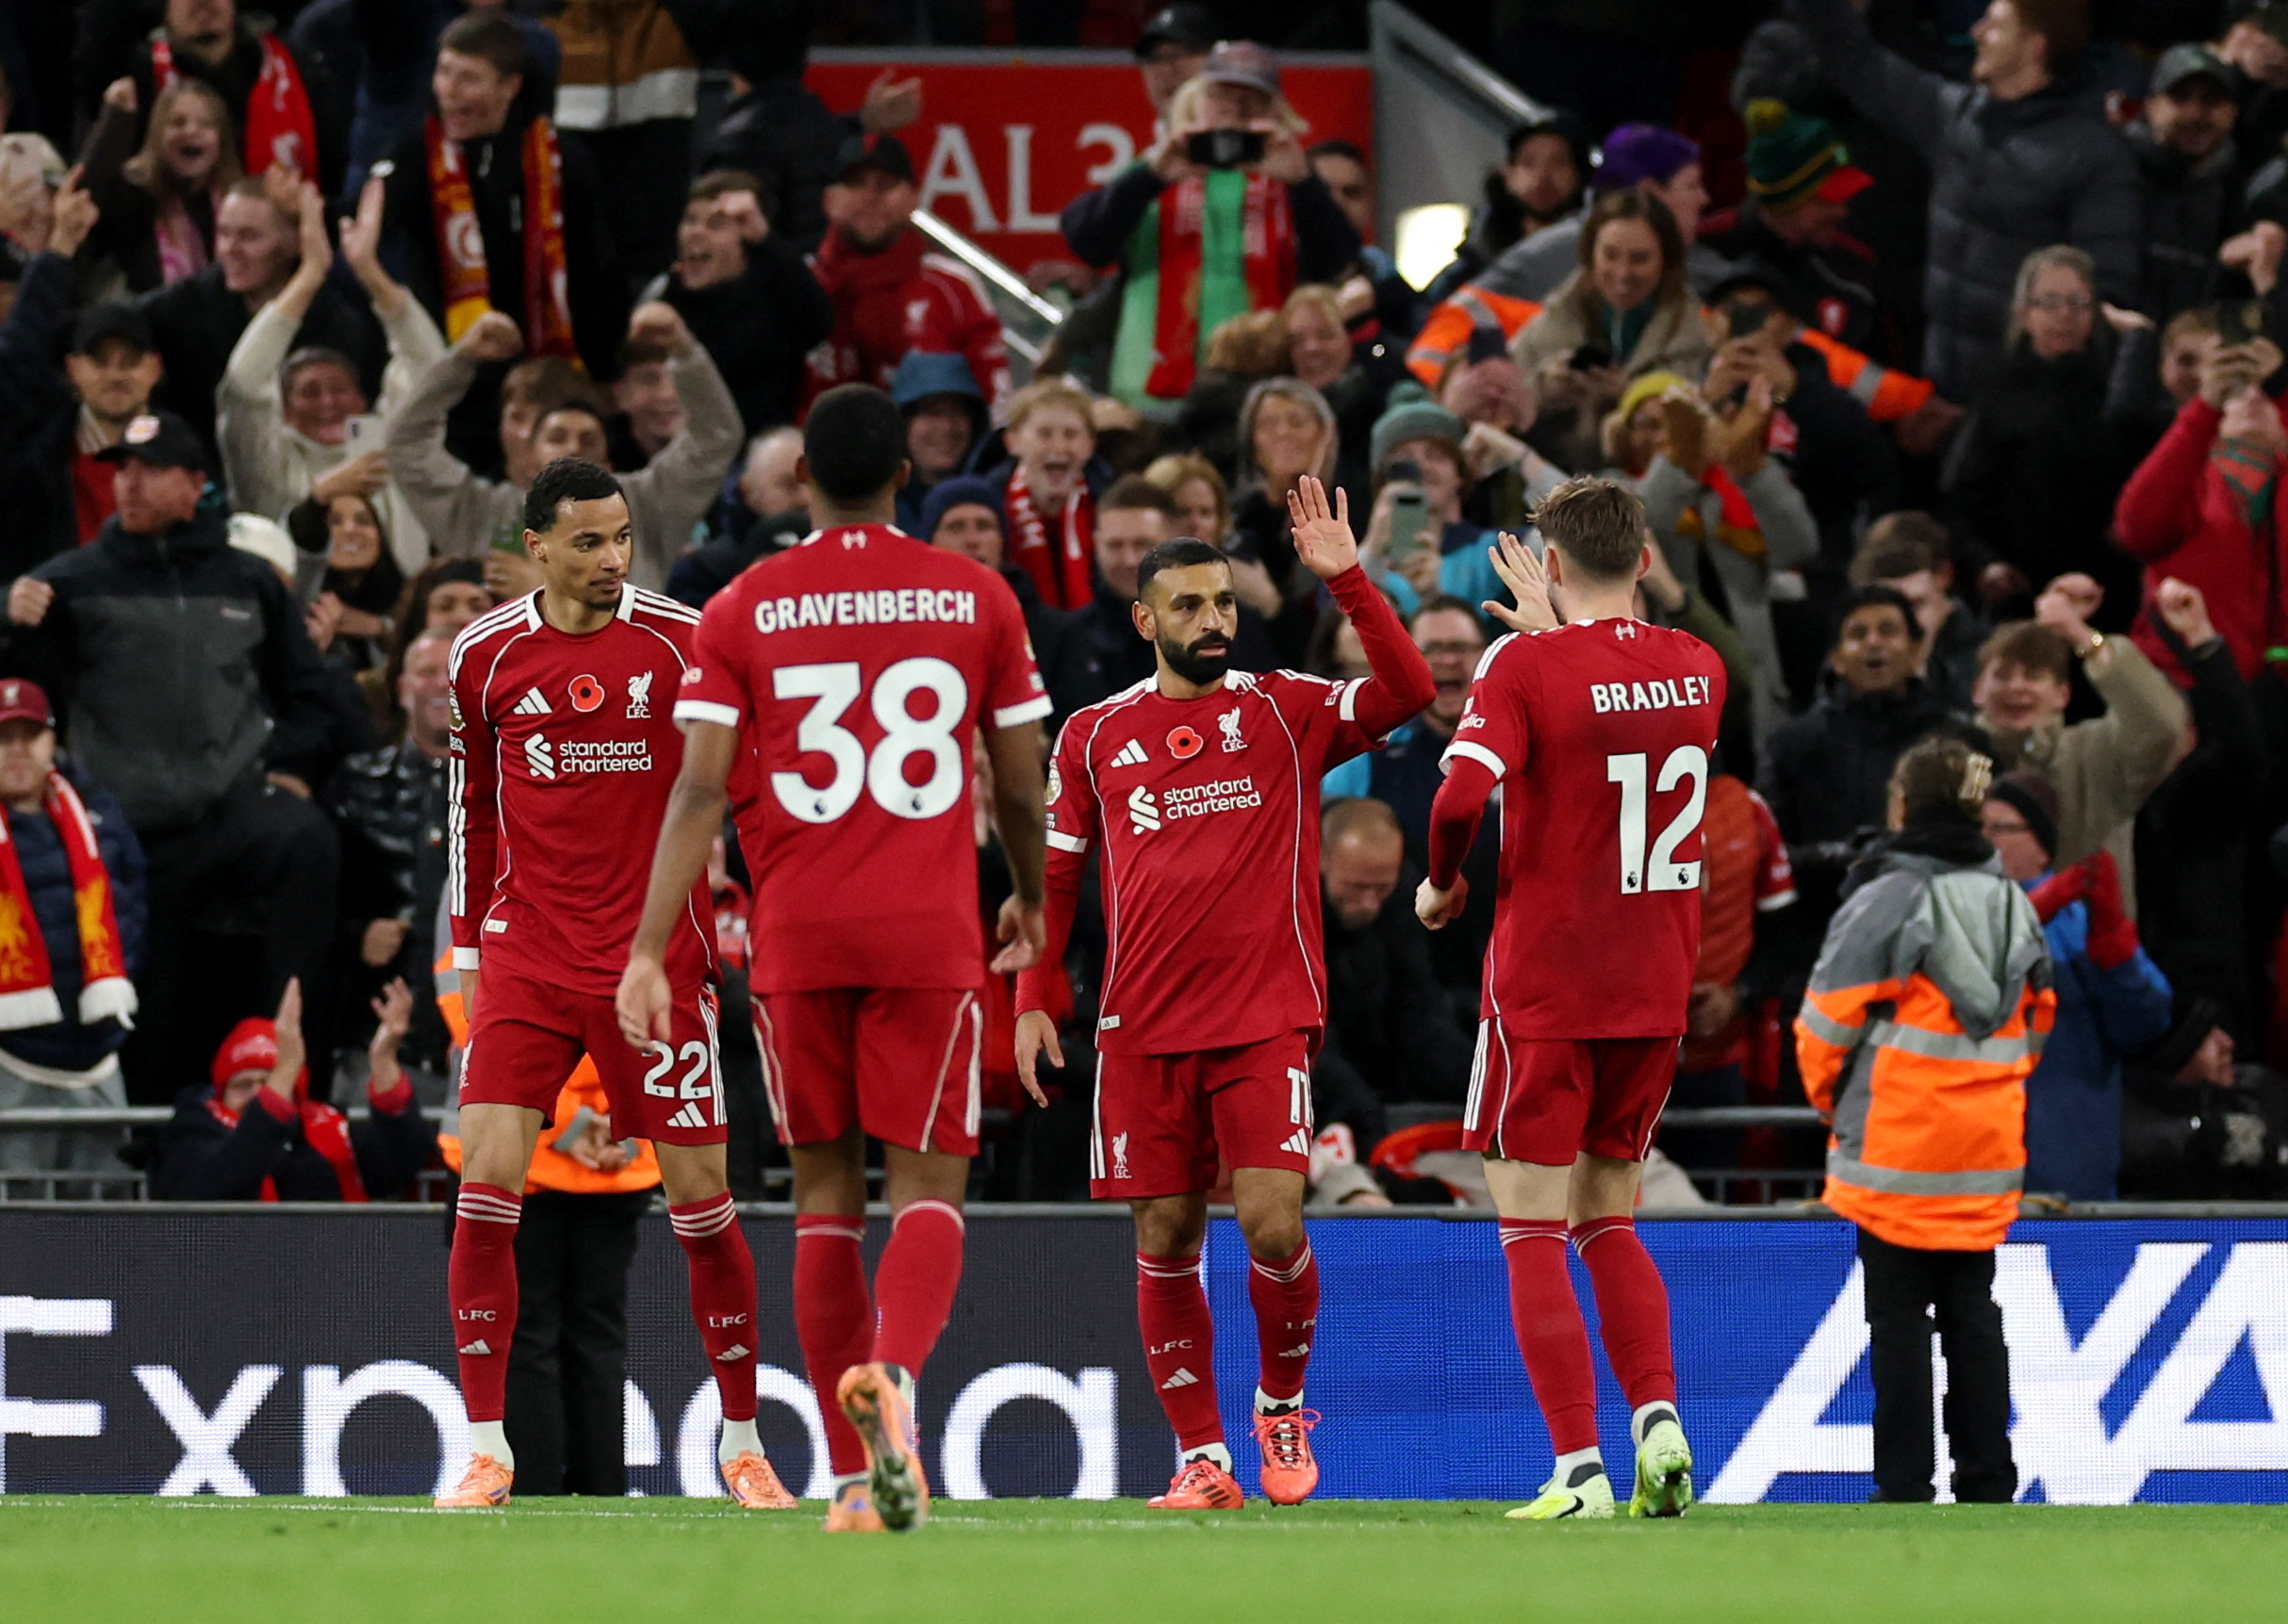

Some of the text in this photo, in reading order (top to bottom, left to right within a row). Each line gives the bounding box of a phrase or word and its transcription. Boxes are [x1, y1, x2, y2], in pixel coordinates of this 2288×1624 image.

[755, 588, 976, 634] GRAVENBERCH
[1590, 676, 1710, 714] BRADLEY
[559, 738, 647, 757] standard
[770, 656, 968, 825] 38
[561, 755, 652, 773] chartered
[1163, 775, 1252, 805] standard
[1166, 791, 1261, 821] chartered
[1607, 745, 1708, 894] 12
[642, 1040, 712, 1100] 22
[458, 1309, 497, 1322] LFC
[709, 1313, 748, 1328] LFC
[1149, 1339, 1193, 1355] LFC
